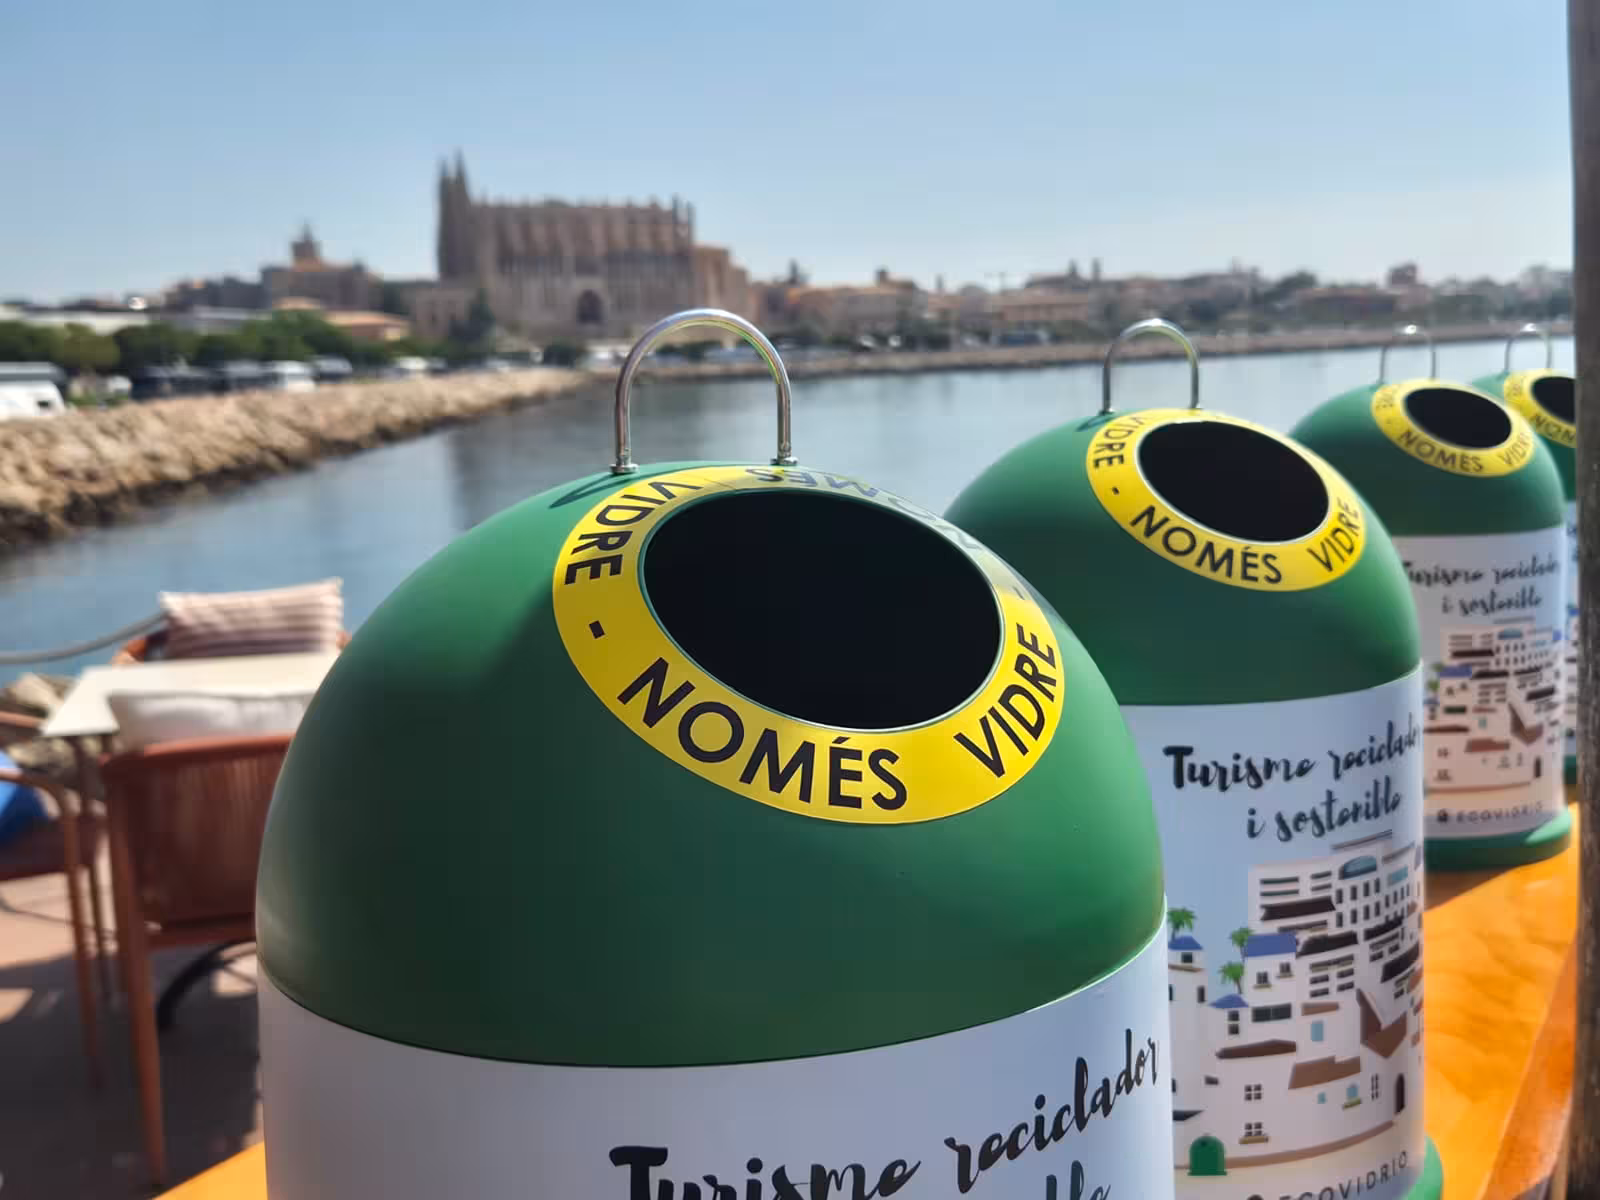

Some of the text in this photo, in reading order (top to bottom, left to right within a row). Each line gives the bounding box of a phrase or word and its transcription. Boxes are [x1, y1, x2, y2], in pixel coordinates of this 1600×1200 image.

[1093, 416, 1145, 469] VIDRE
[564, 481, 704, 585] VIDRE
[1130, 497, 1360, 584] NOMÉS VIDRE
[617, 622, 1057, 811] NOMÉS VIDRE
[1162, 745, 1316, 792] Turismo
[1247, 775, 1401, 842] i sostenible
[944, 1028, 1158, 1194] reciclador
[1279, 1150, 1408, 1200] OVIDRIO
